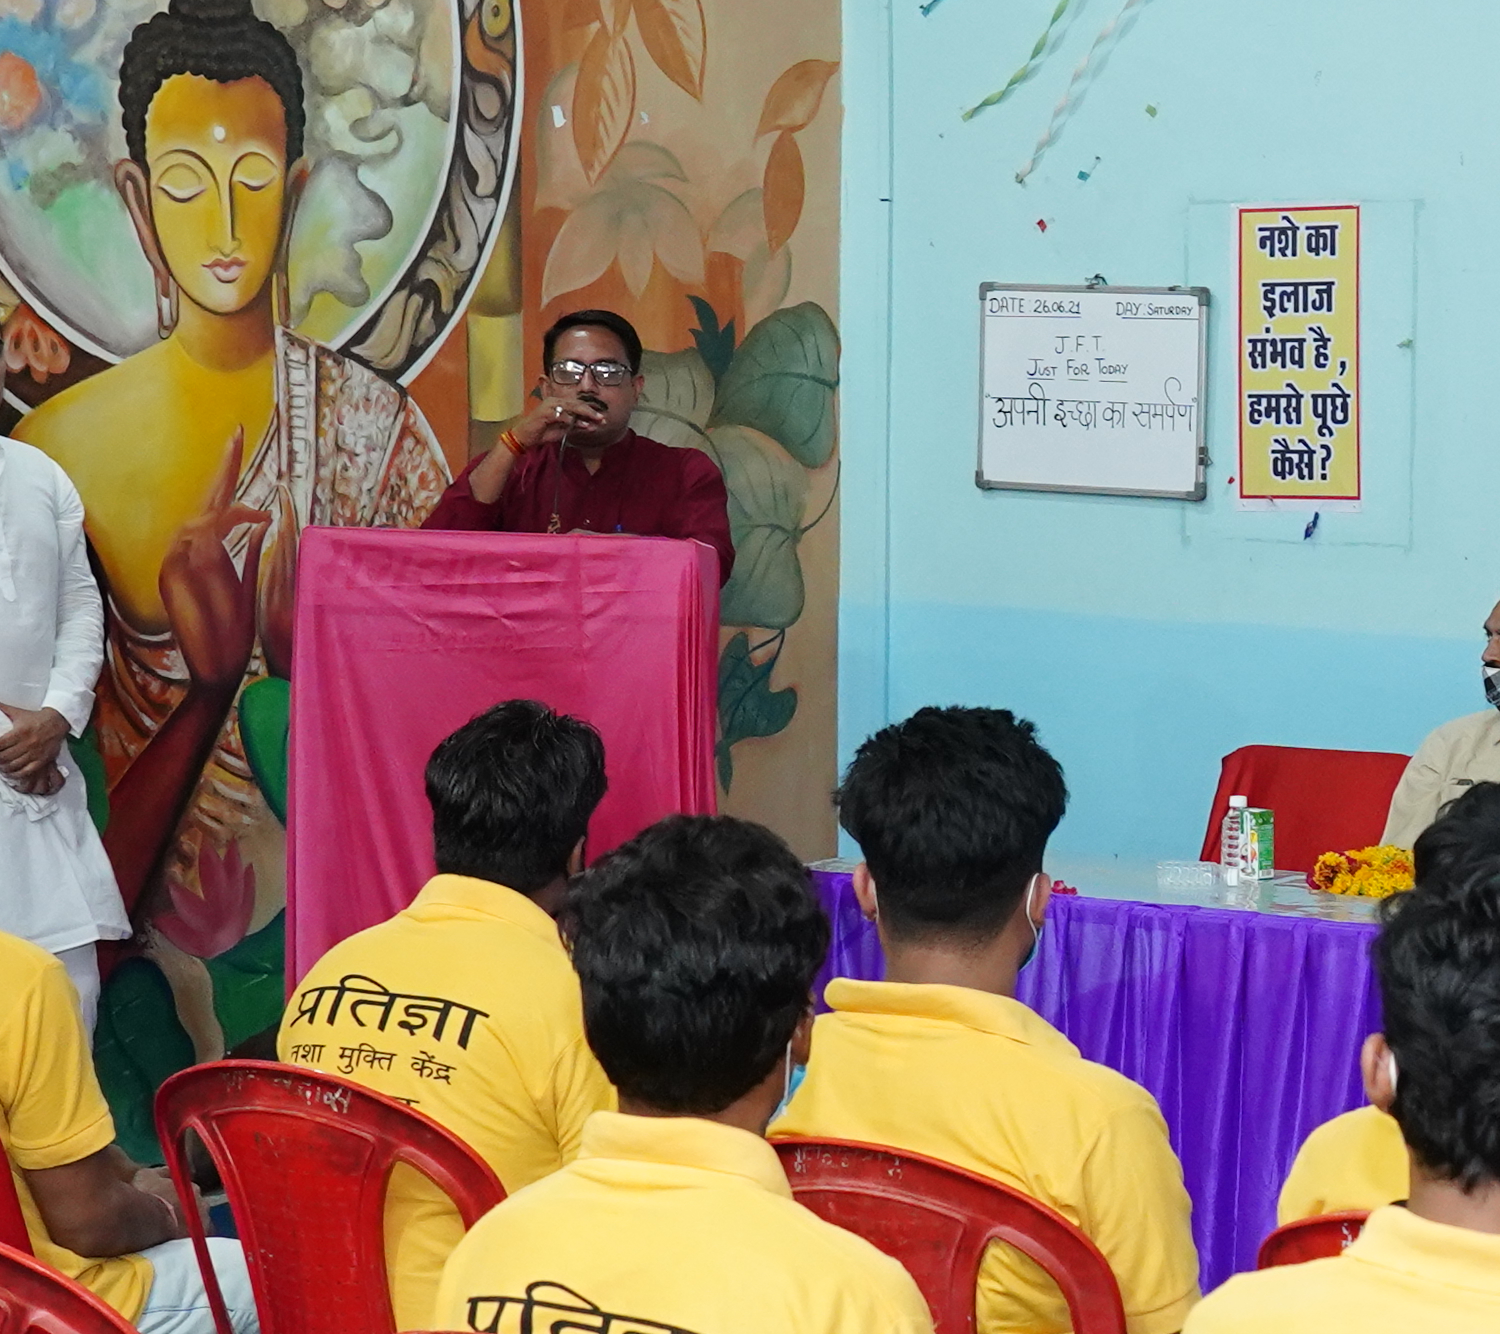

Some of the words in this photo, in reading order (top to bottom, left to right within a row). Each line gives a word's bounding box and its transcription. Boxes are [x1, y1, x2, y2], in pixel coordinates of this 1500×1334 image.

[1257, 215, 1299, 257] नशे
[1305, 224, 1339, 256] का
[1260, 280, 1335, 317] इलाज
[1247, 326, 1306, 369] संभव
[1055, 399, 1100, 431] इच्छा
[1102, 400, 1129, 429] का
[1247, 383, 1304, 425] हमसे
[1310, 382, 1351, 437] पूछे
[290, 974, 490, 1050] प्रतिज्ञा
[337, 1042, 398, 1075] मुक्ति
[410, 1050, 457, 1085] केंद्र
